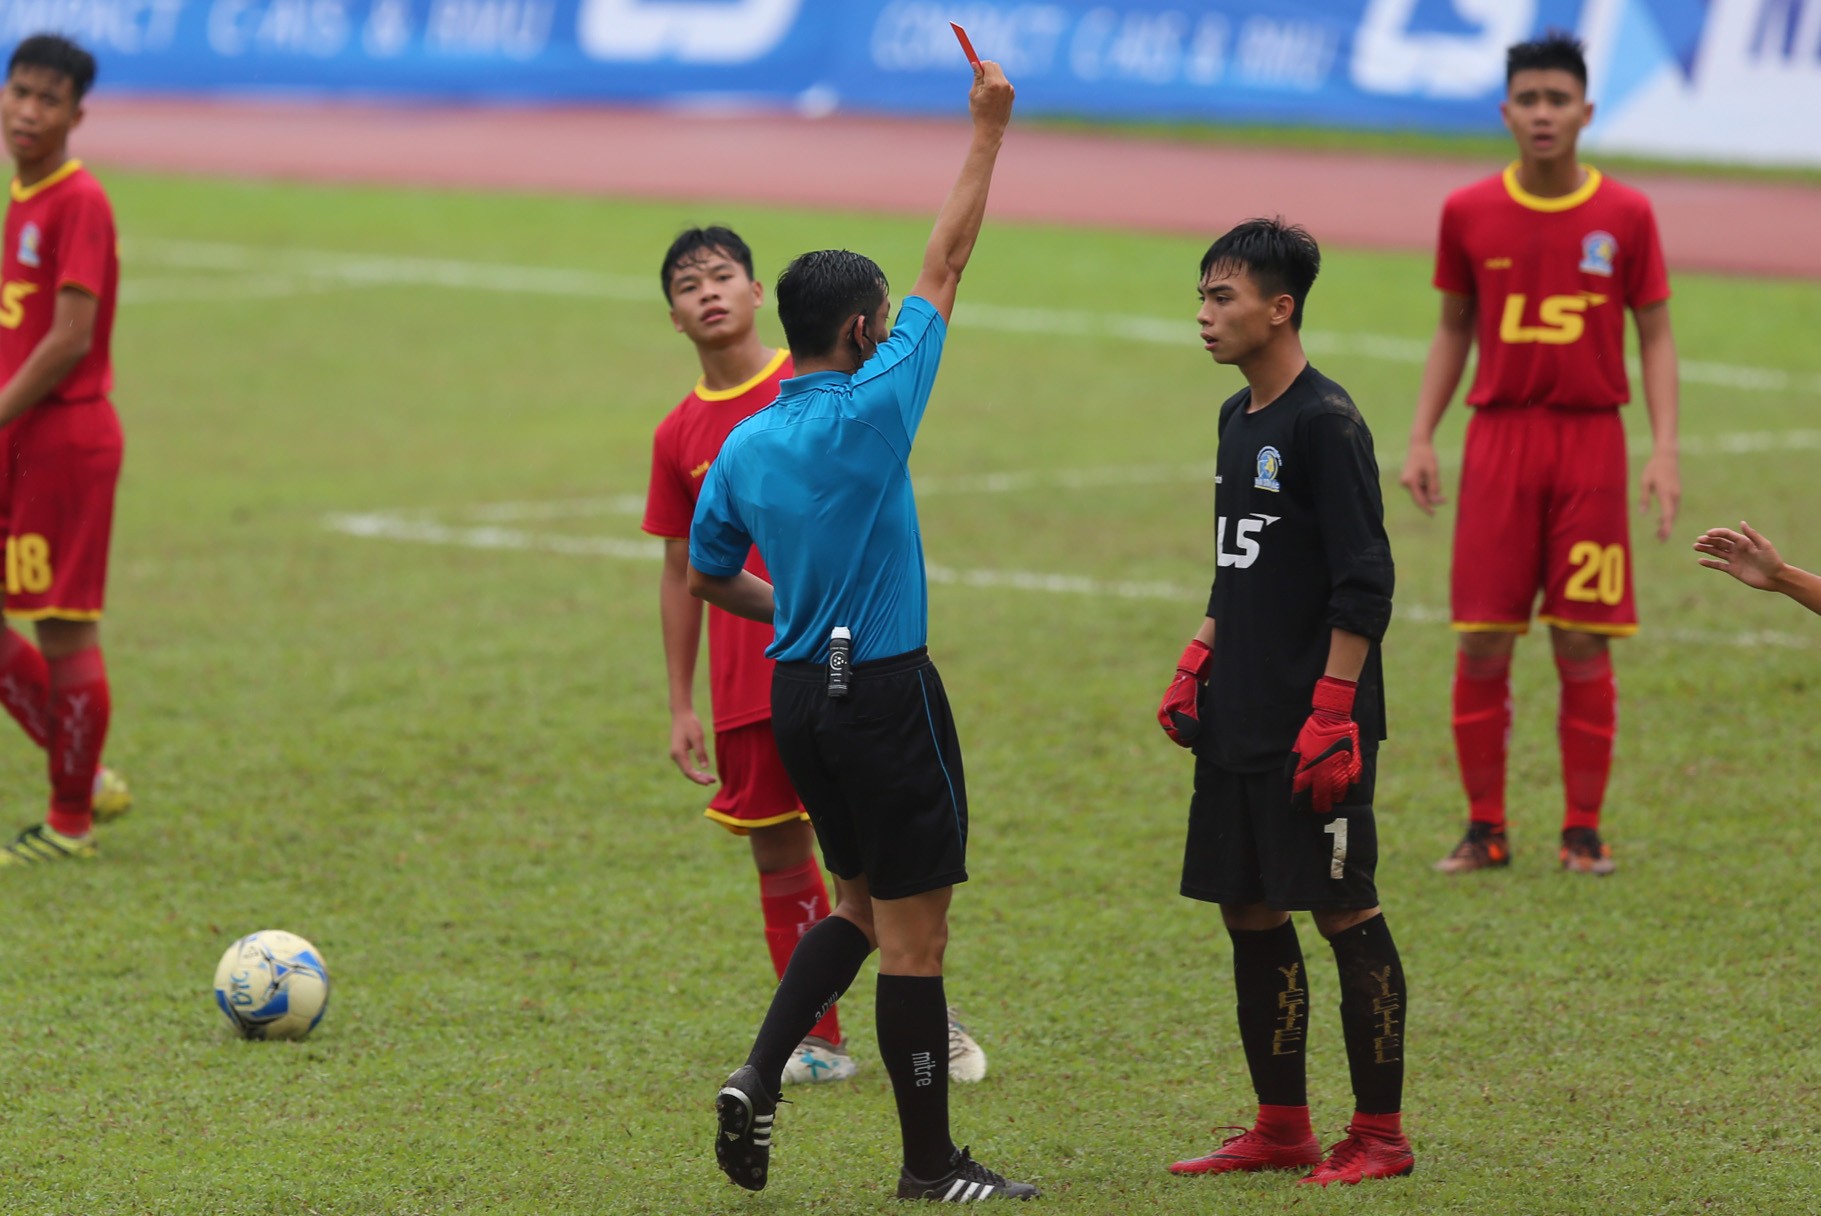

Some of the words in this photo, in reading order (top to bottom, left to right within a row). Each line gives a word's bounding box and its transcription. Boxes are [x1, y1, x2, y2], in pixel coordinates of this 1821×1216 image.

[1499, 292, 1592, 345] LS
[5, 532, 53, 595] 18
[1216, 515, 1266, 569] LS
[1564, 540, 1626, 606] 20
[1323, 817, 1348, 880] 1
[911, 1051, 937, 1087] mitre
